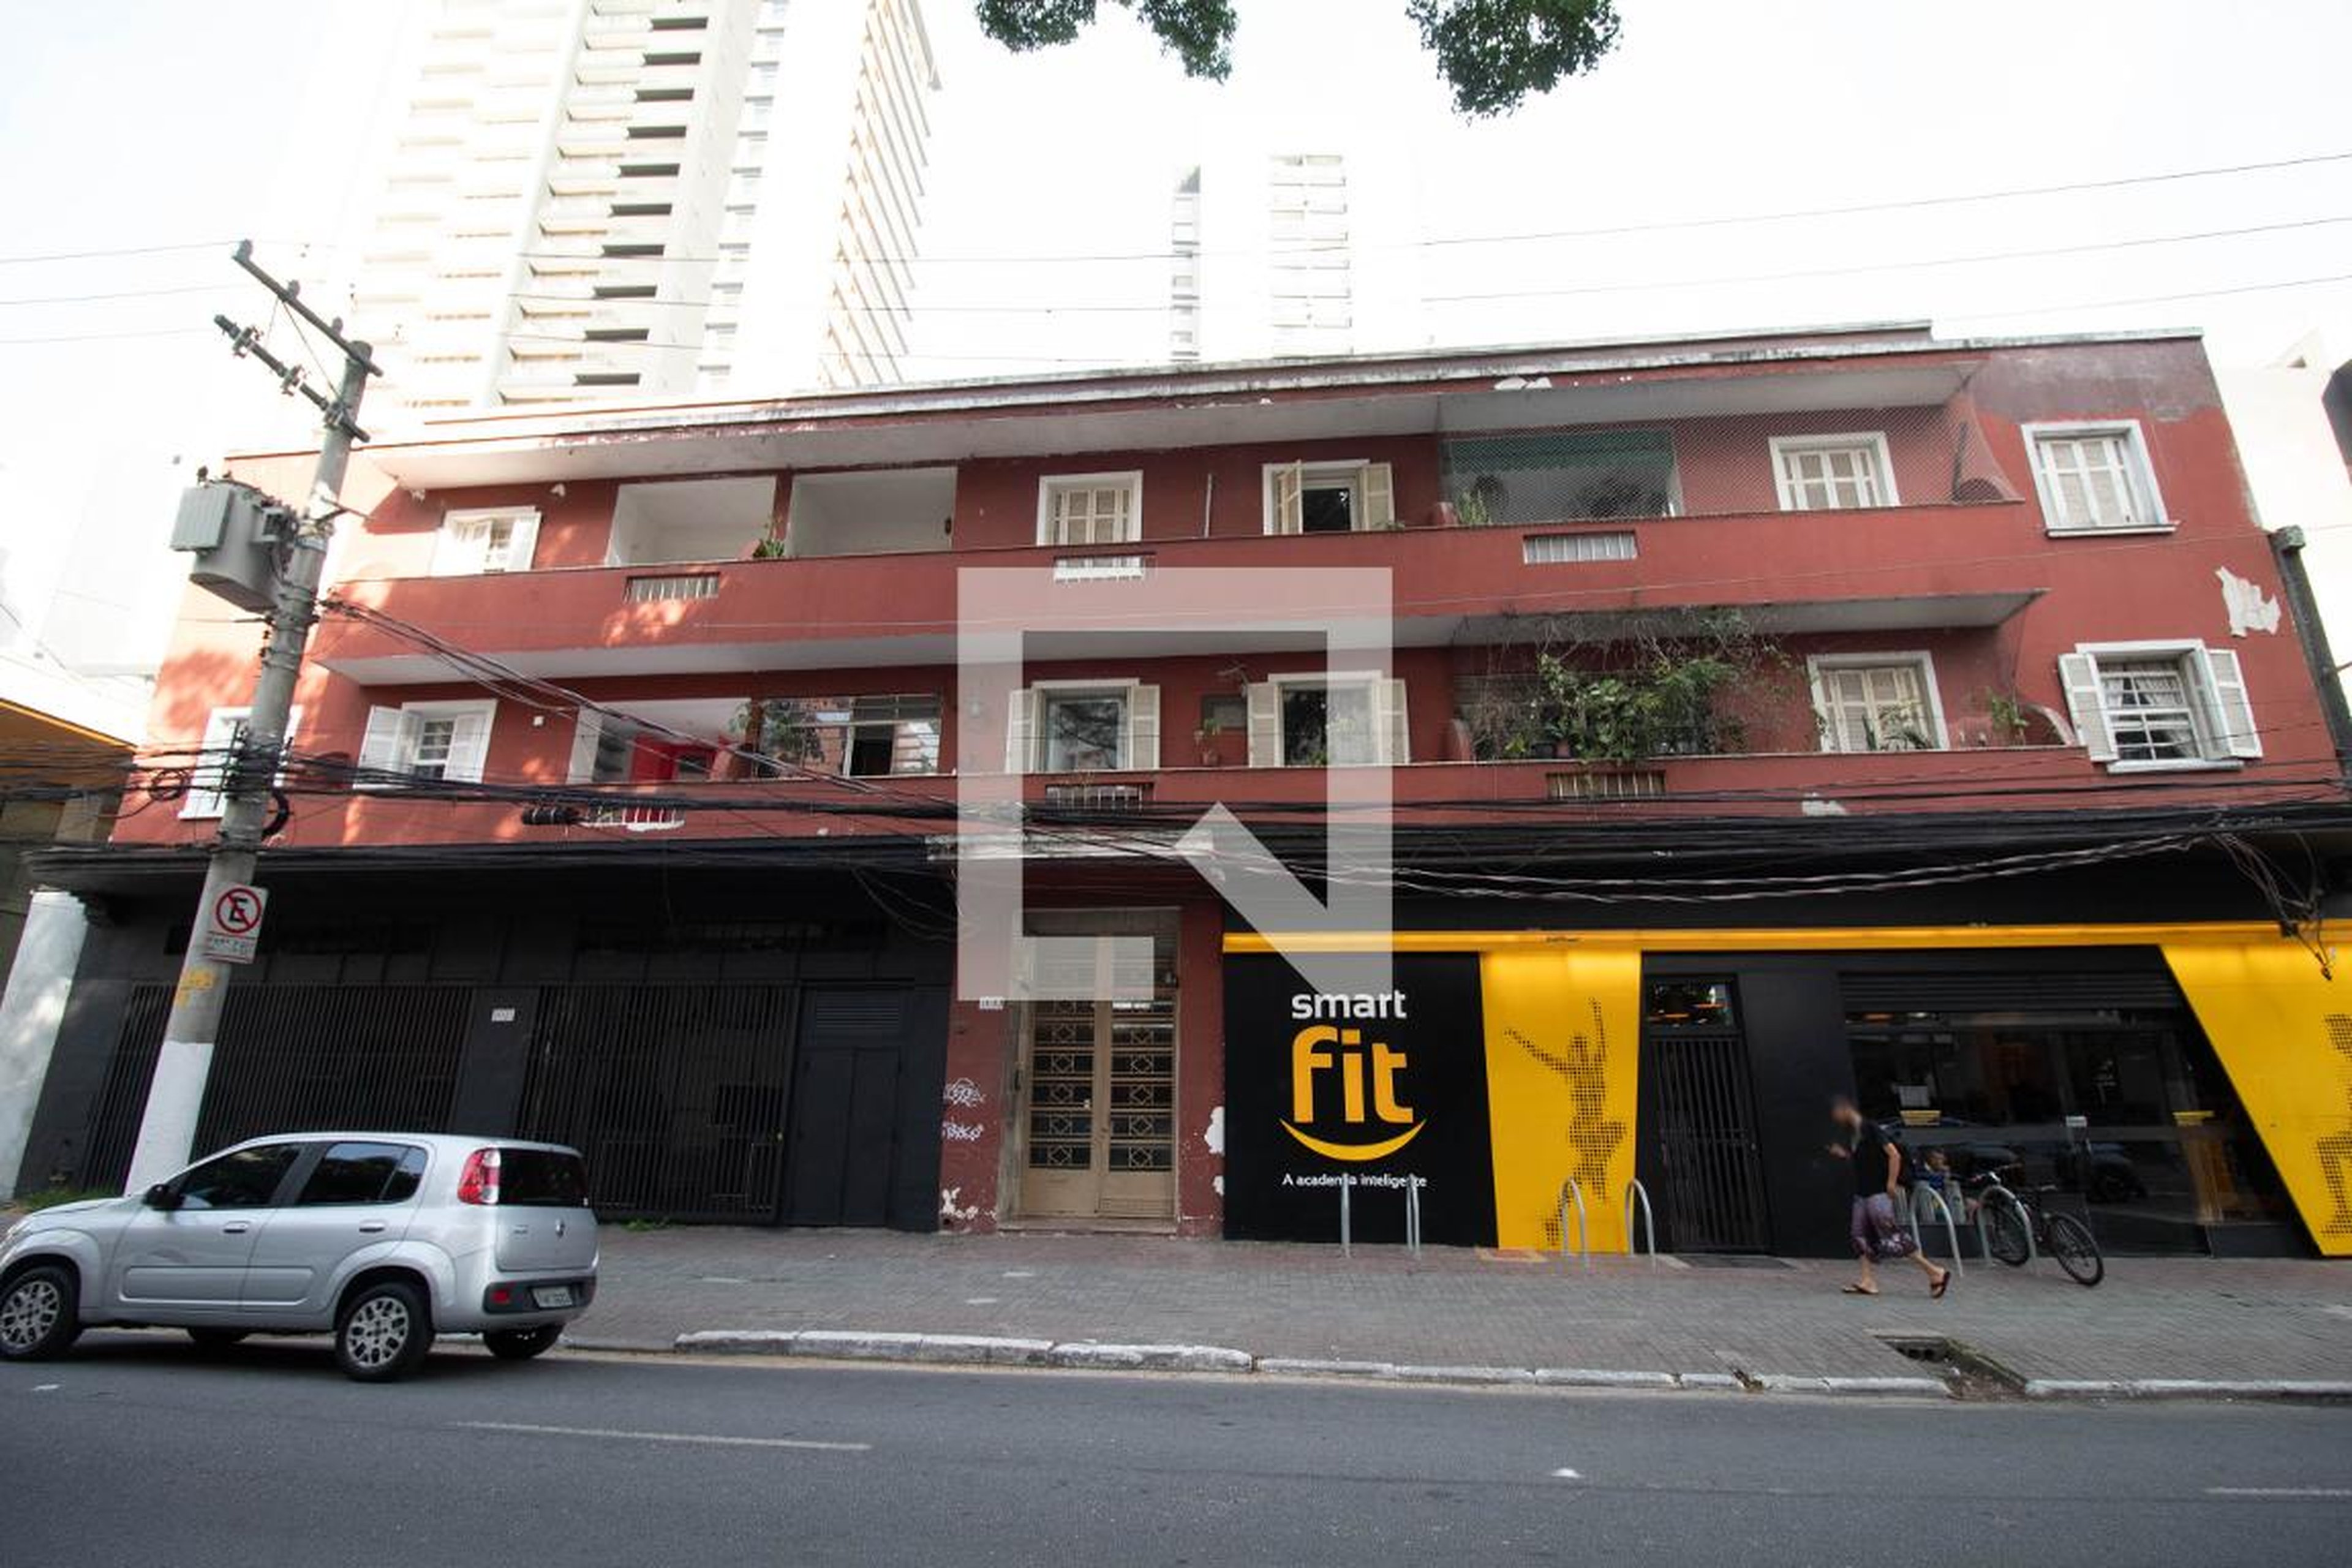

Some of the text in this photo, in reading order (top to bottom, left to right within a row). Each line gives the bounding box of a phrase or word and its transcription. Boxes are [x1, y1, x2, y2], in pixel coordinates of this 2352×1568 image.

[1291, 990, 1408, 1019] smart
[1292, 1025, 1414, 1123] fit
[1282, 1172, 1428, 1189] A academa inteligete
